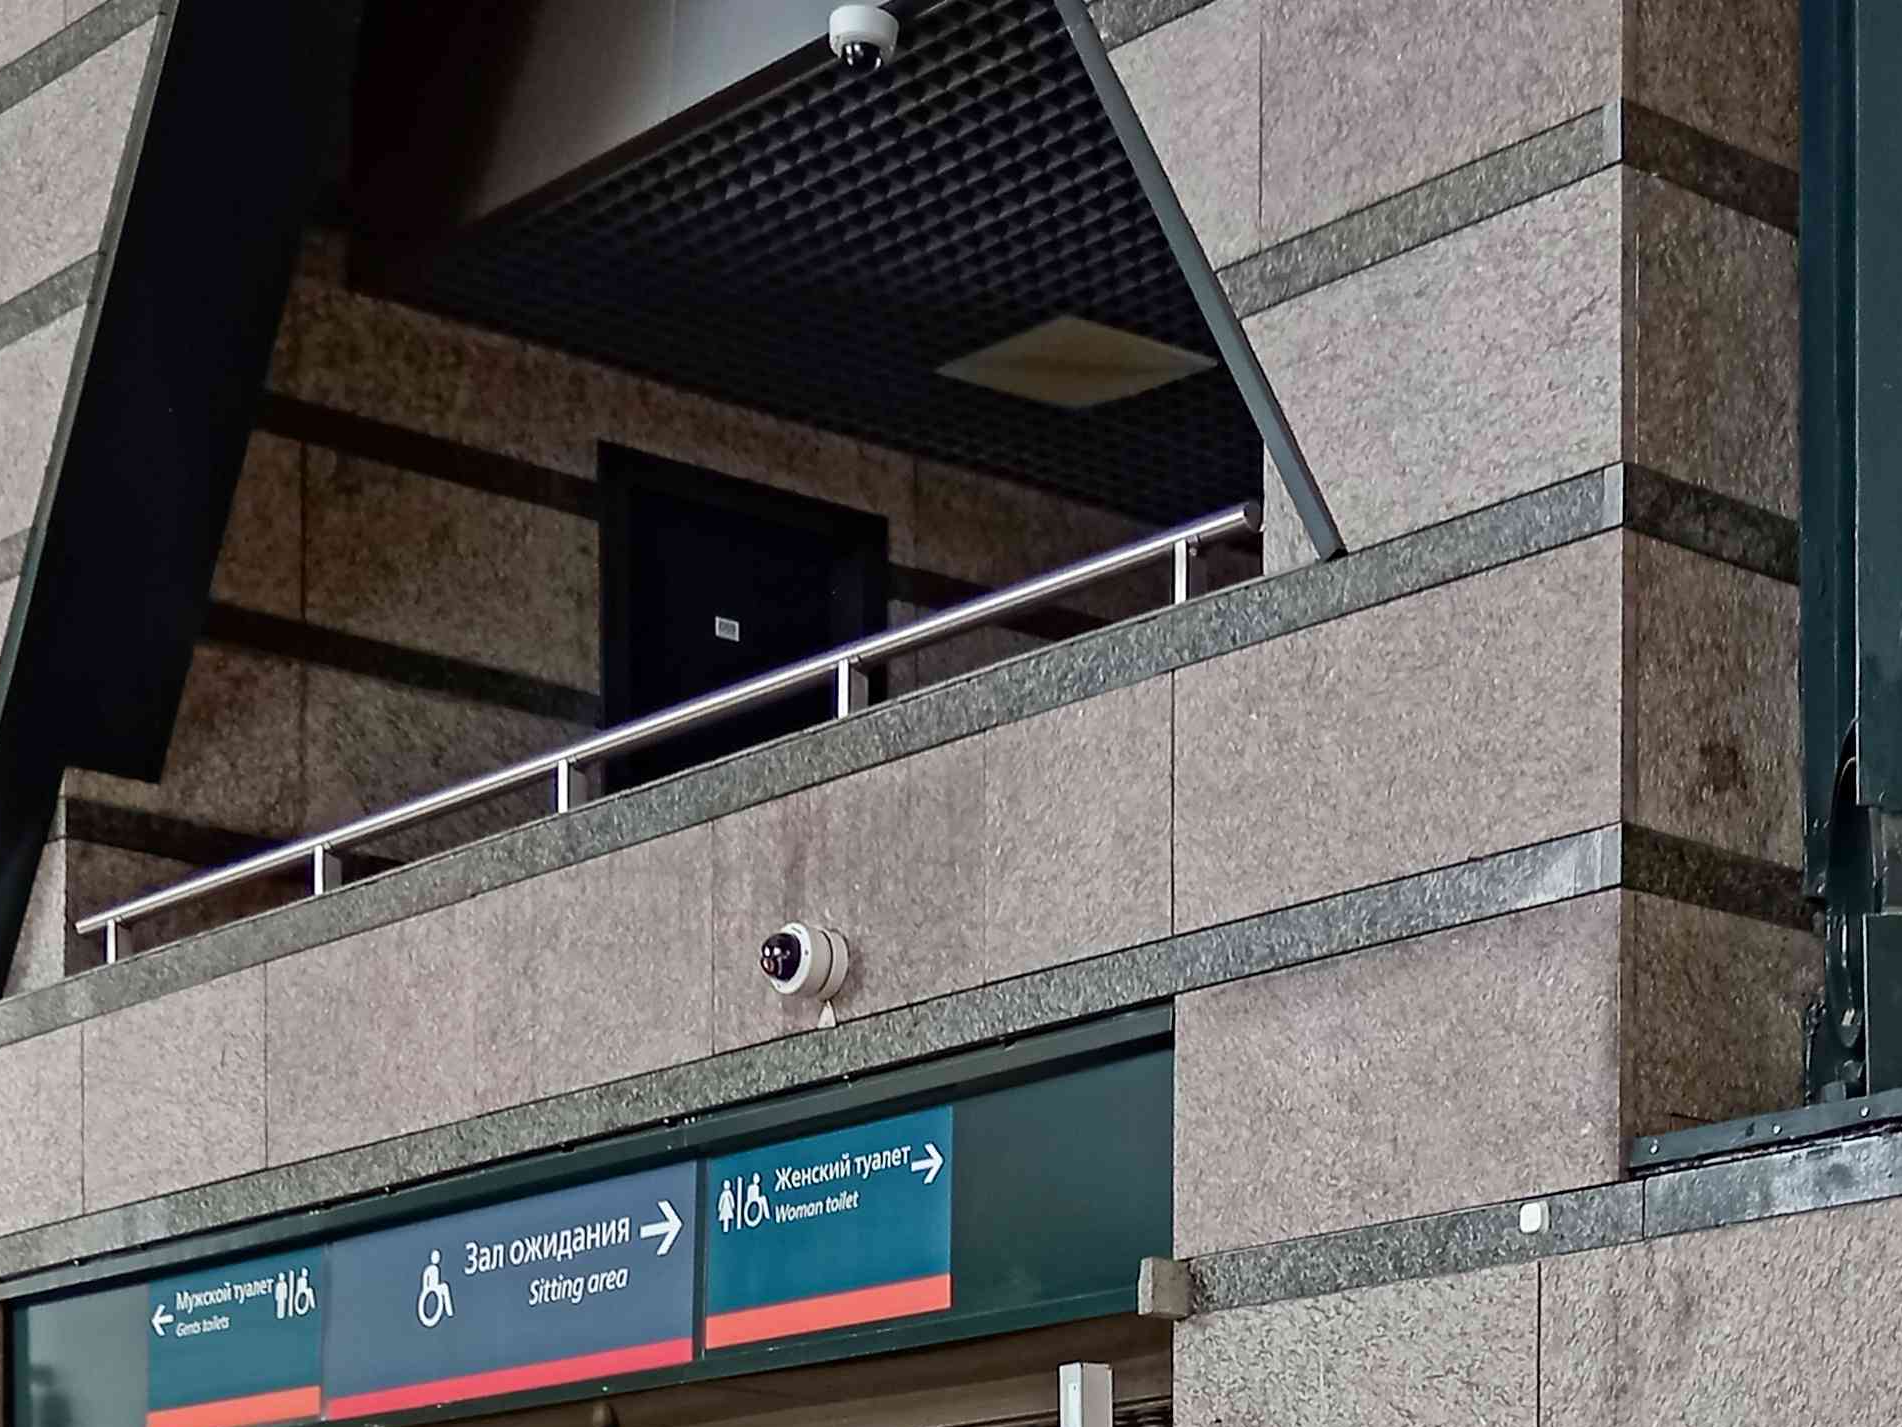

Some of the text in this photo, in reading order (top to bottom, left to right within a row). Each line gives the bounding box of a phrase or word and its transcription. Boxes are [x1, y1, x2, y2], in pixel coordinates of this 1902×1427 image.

[774, 1145, 911, 1192] Женский туалет
[775, 1190, 860, 1224] Woman toilet
[464, 1217, 630, 1275] Зал ожидания
[176, 1278, 274, 1314] Мужской туалет
[528, 1268, 628, 1304] Sitting area
[176, 1315, 229, 1337] Gents toilets
